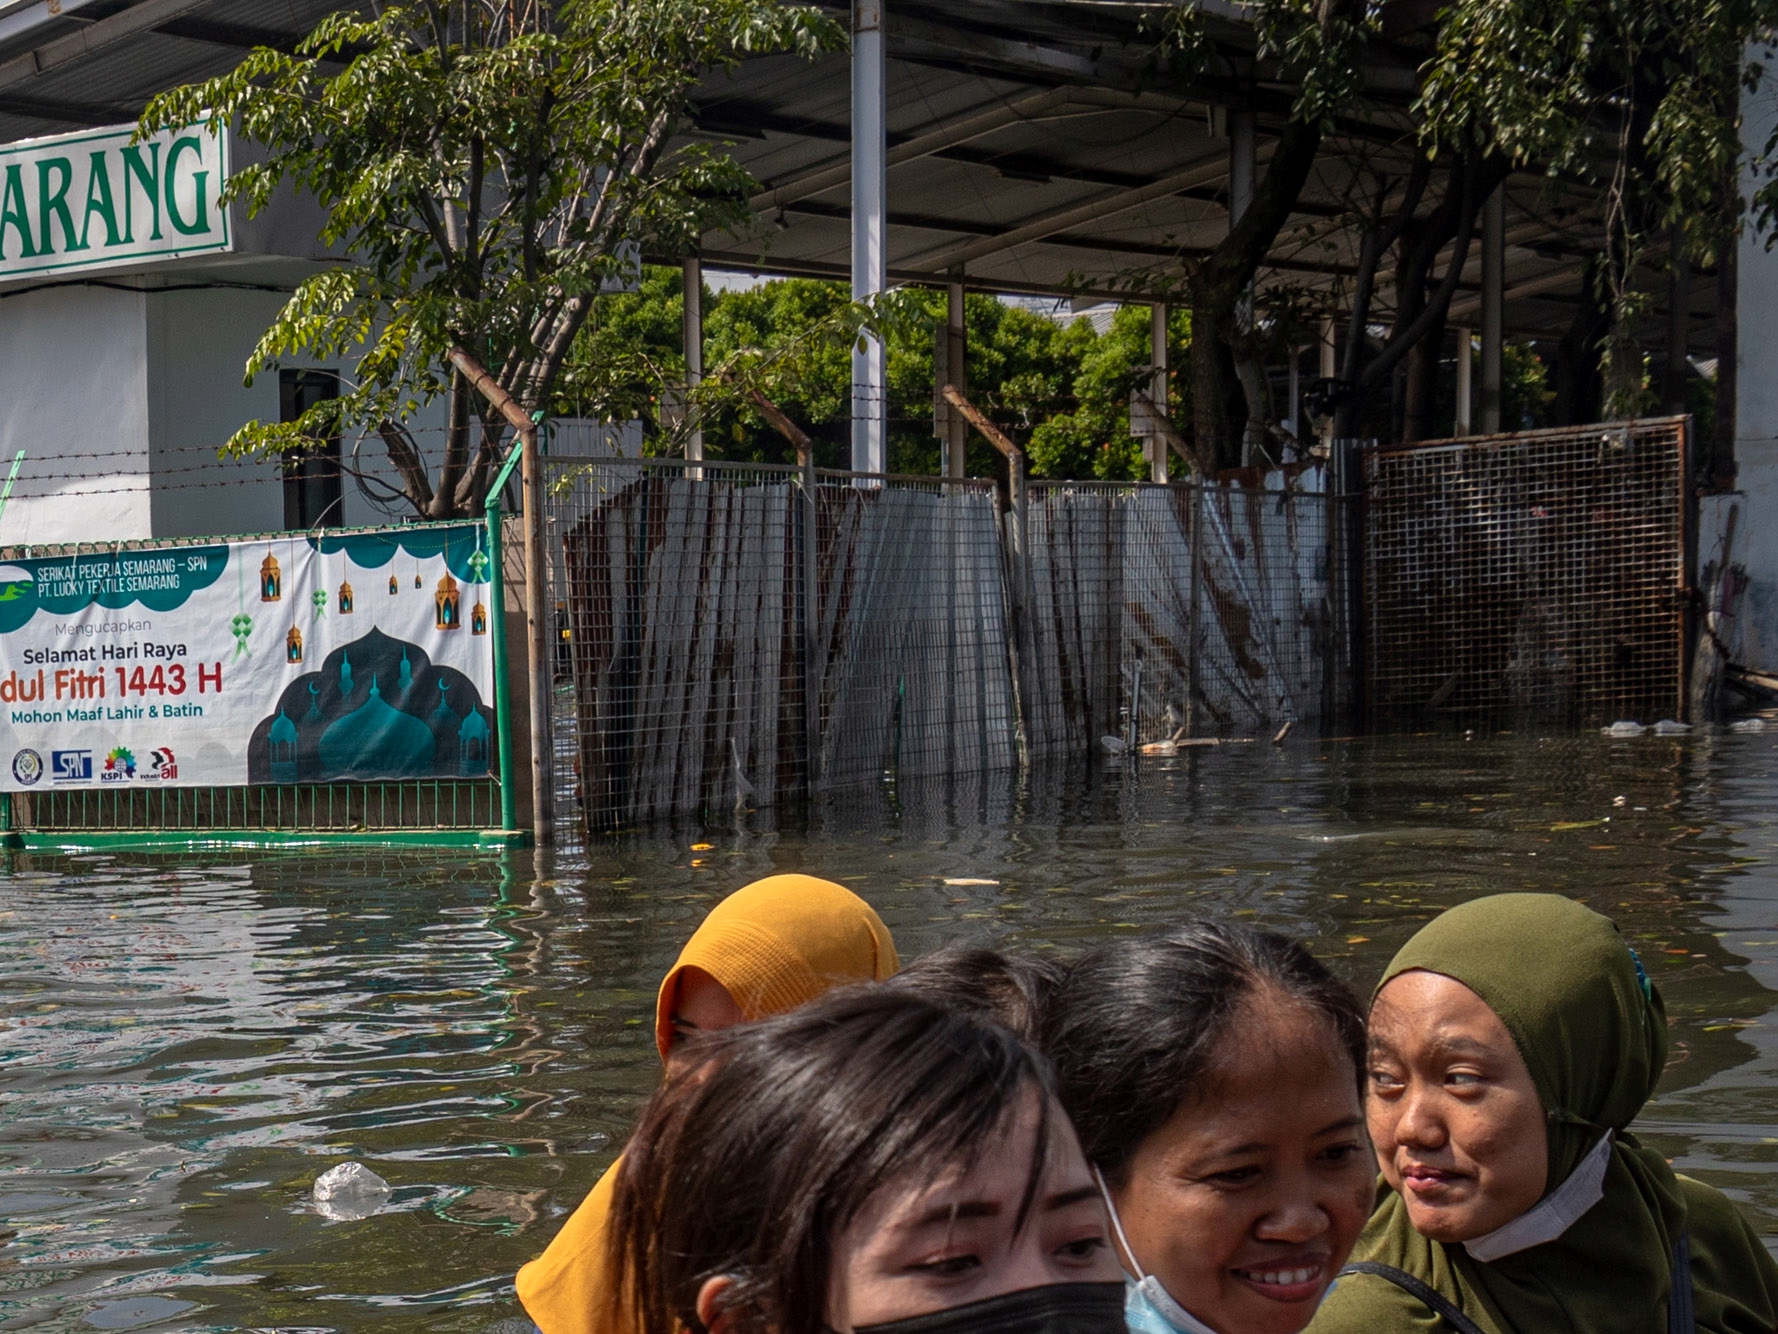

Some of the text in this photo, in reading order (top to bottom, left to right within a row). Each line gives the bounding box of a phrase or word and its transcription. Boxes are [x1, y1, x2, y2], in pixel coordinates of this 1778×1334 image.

[37, 565, 76, 583] SERIKAT
[79, 562, 121, 580] PEKERJA
[123, 559, 176, 577] SEMARANG
[187, 556, 208, 571] SPN
[38, 574, 180, 598] PT. LUCKY TEXTILE SEMARANG
[54, 618, 152, 638] Mengucapkan
[23, 642, 187, 665] Selamat Hari Raya
[55, 666, 105, 700] Fitri
[115, 663, 187, 697] 1443
[198, 661, 222, 694] H
[11, 702, 203, 724] Mohon Maaf Lahir & Batin
[101, 772, 122, 780] KSPI
